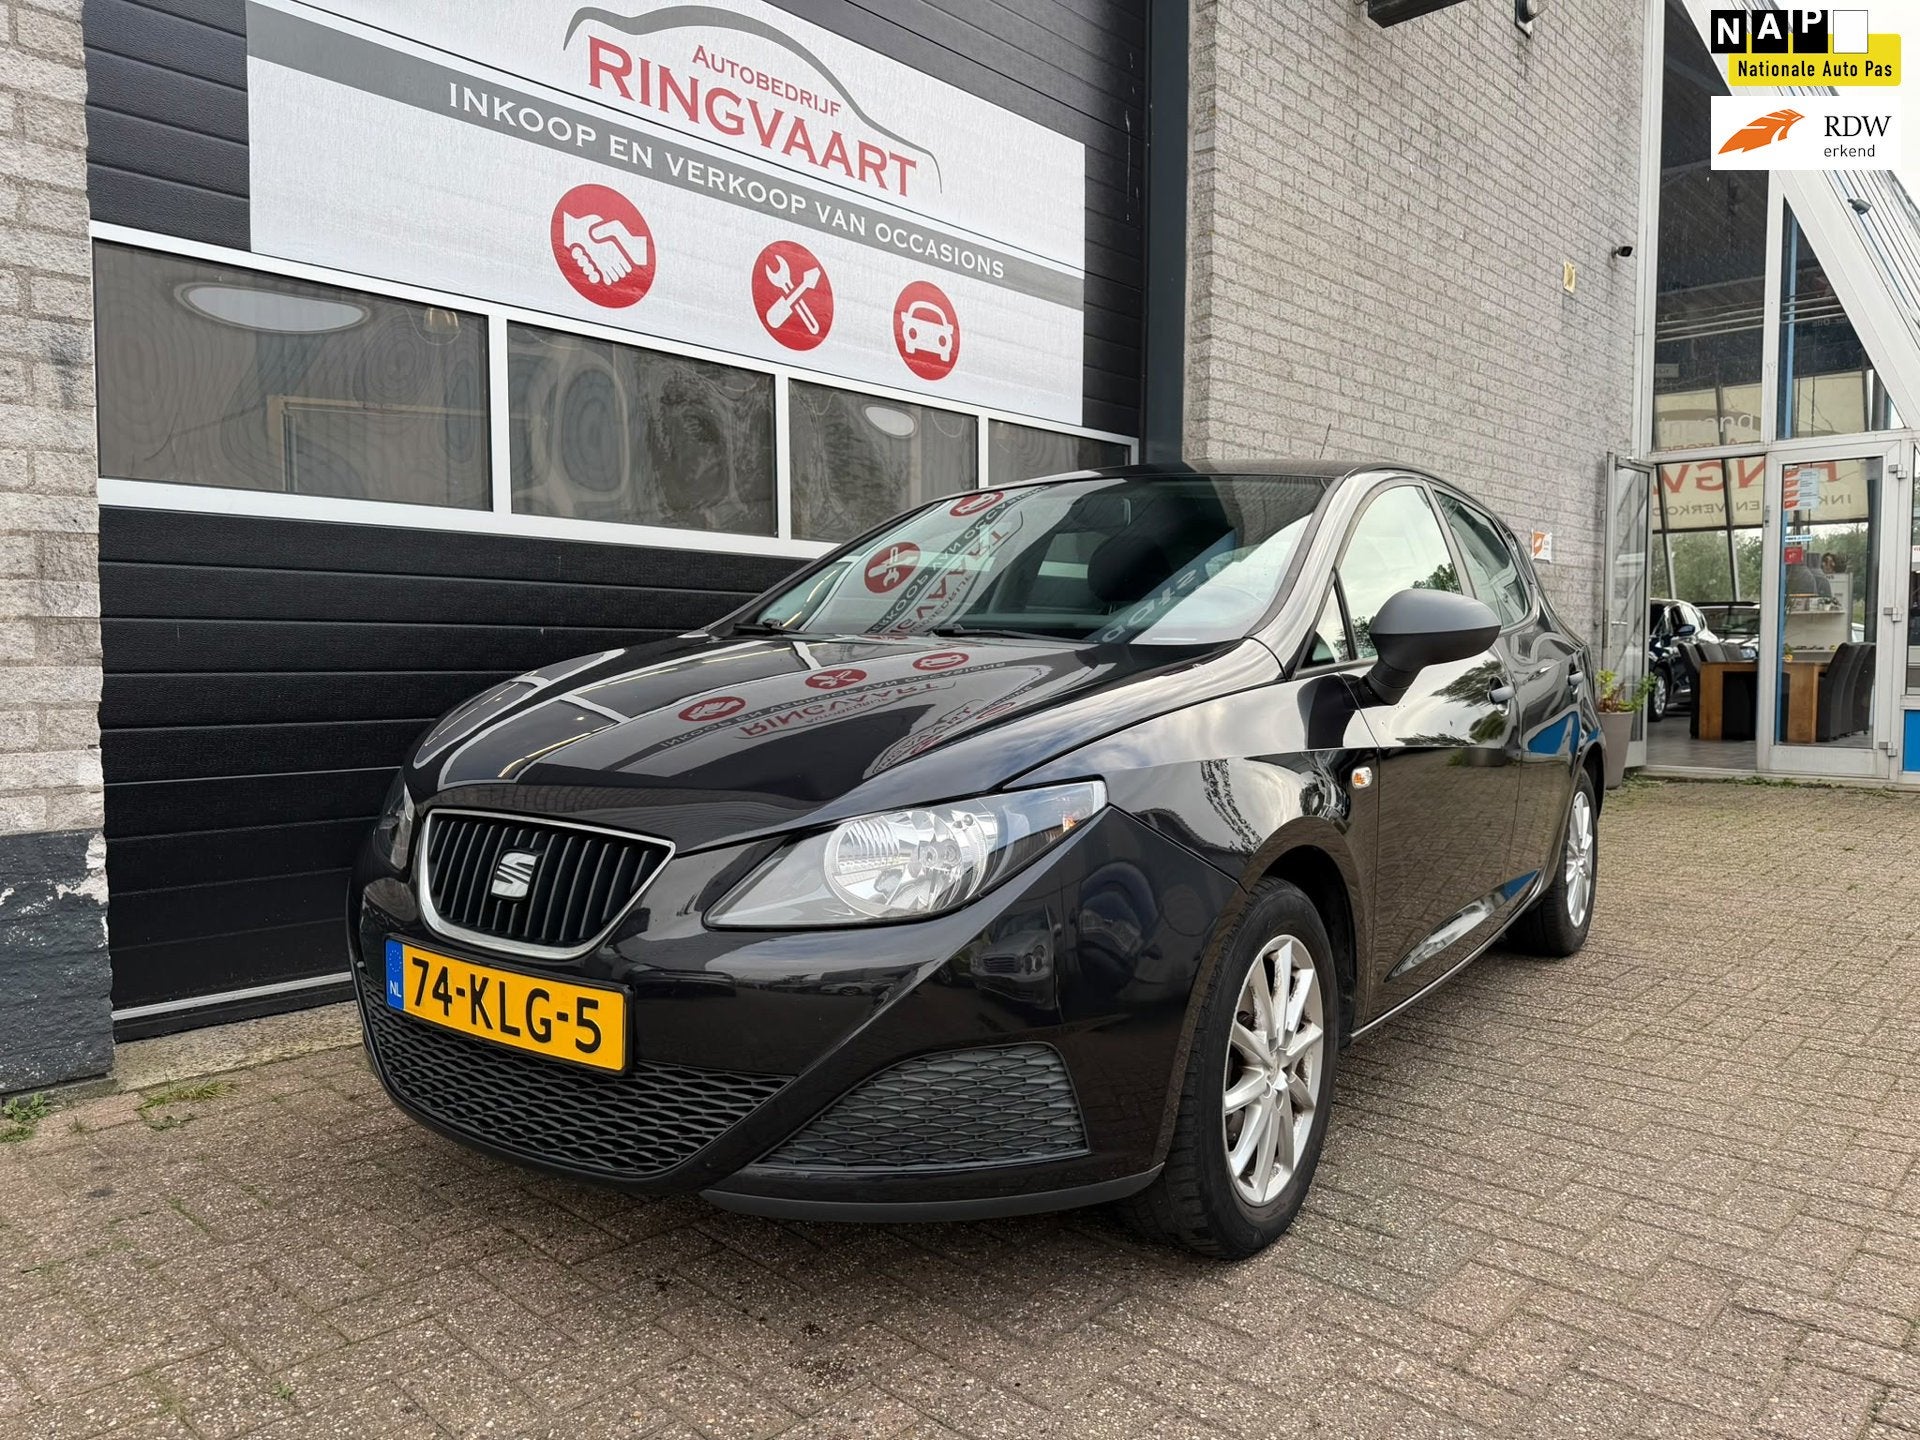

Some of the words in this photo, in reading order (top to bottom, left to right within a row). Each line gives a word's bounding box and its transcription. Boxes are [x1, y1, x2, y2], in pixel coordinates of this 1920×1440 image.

[587, 35, 918, 198] RINGVAART
[691, 44, 842, 120] AUTOBEDRIJF
[448, 82, 598, 150] INKOOP
[609, 137, 653, 169] EN
[664, 152, 807, 215] VERKOOP
[814, 201, 866, 238] VAN
[875, 222, 1005, 280] OCCASIONS
[388, 980, 402, 999] NL
[411, 957, 602, 1055] 74-KLG-5
